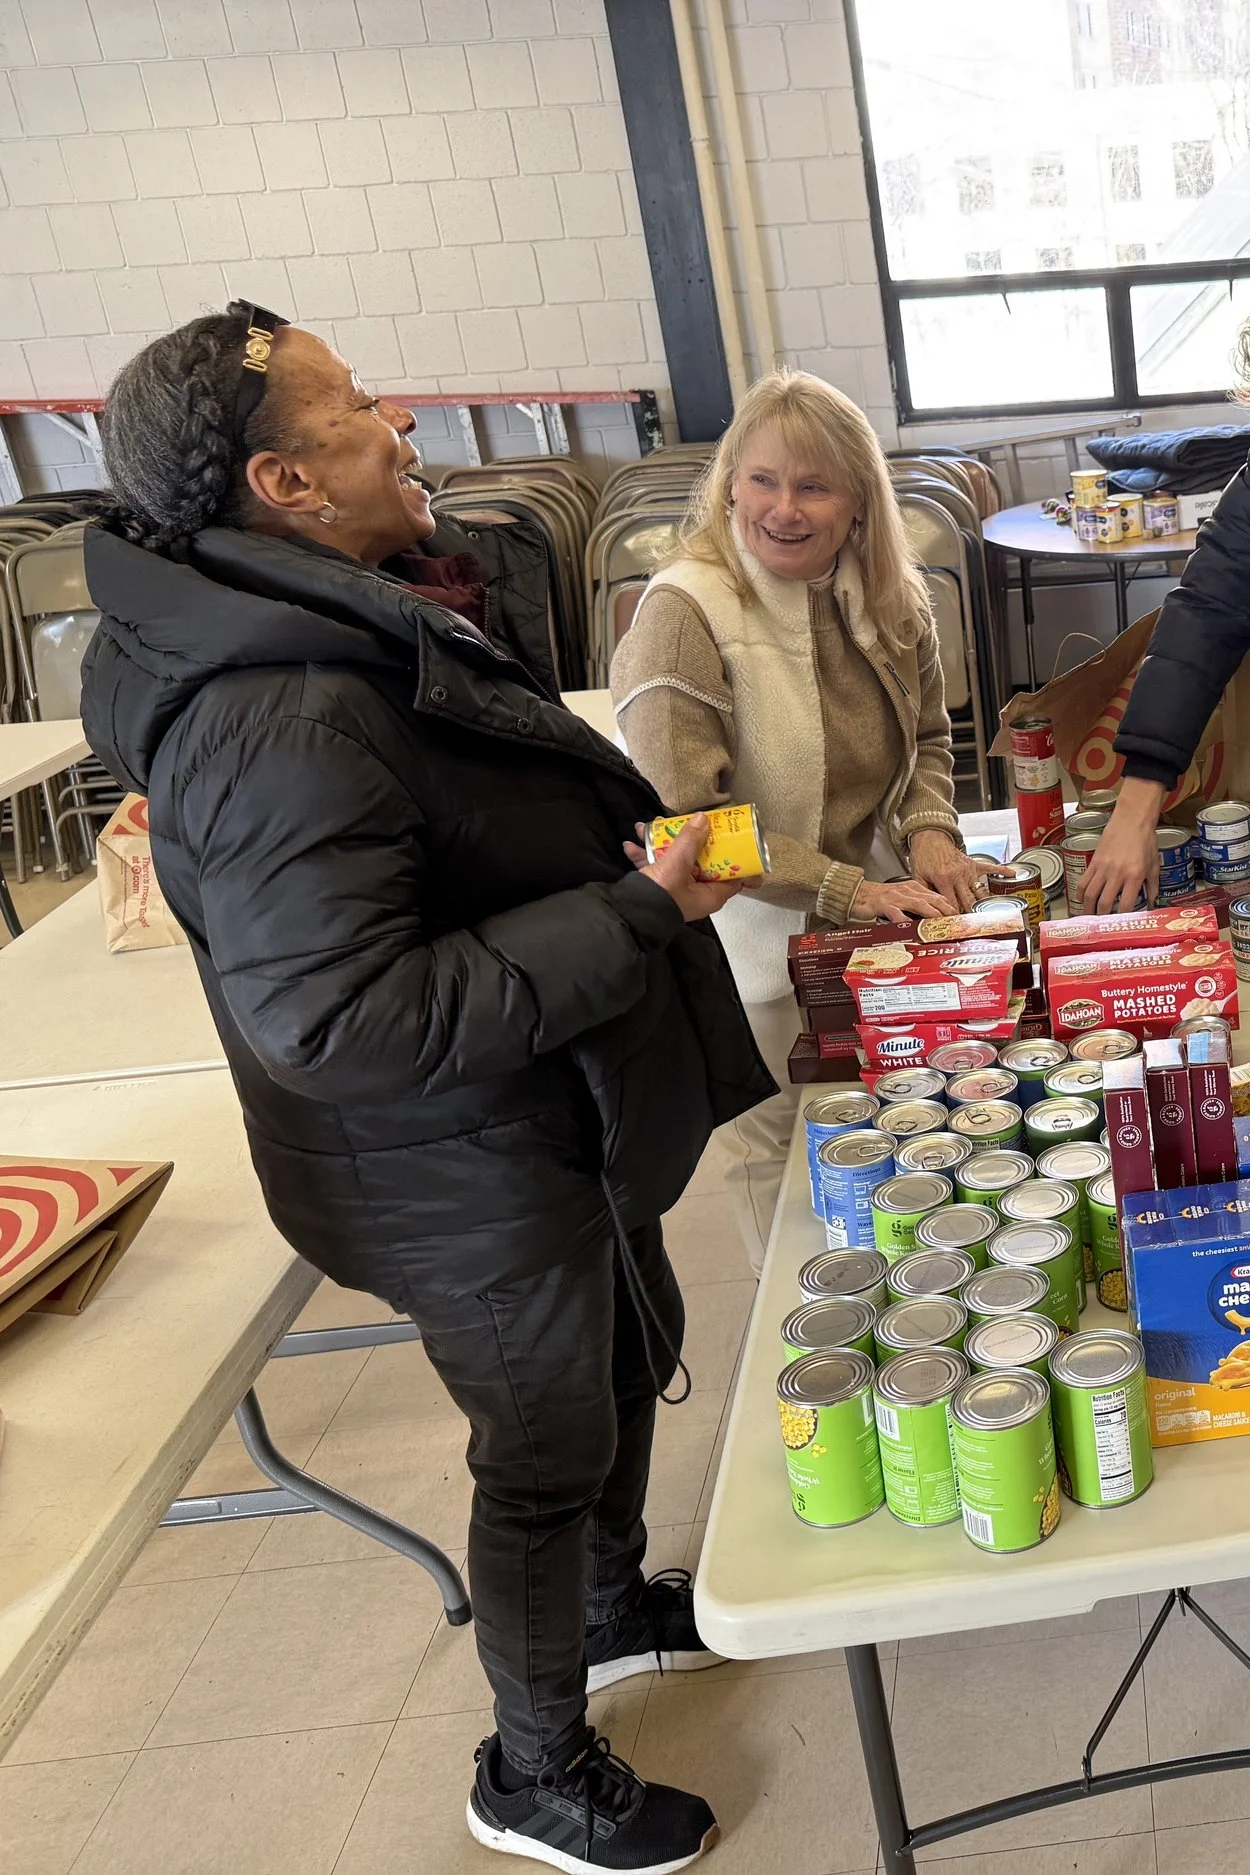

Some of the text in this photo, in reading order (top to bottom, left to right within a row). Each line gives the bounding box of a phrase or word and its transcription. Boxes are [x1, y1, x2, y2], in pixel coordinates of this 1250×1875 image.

[142, 856, 151, 884] There's
[1220, 864, 1247, 872] StarKist
[1163, 887, 1190, 896] StarKist
[917, 948, 955, 957] RICE
[1110, 954, 1171, 966] MASHED
[1058, 963, 1098, 974] IDAHOAN
[1101, 982, 1187, 999] Buttery Homestyle
[1113, 995, 1176, 1010] MASHED
[1062, 1008, 1102, 1023] IDAHOAN
[1114, 1005, 1177, 1019] POTATOES
[877, 1038, 924, 1054] Minute
[880, 1057, 923, 1067] WHITE
[852, 1168, 881, 1177] Directions
[1192, 1250, 1205, 1258] the
[1205, 1245, 1238, 1257] cheesiest
[1053, 1294, 1068, 1304] Corn
[1092, 1389, 1125, 1402] Nutrition Facts
[1154, 1387, 1196, 1402] original
[1213, 1419, 1232, 1429] CHEESE
[1233, 1417, 1250, 1426] SAUCE
